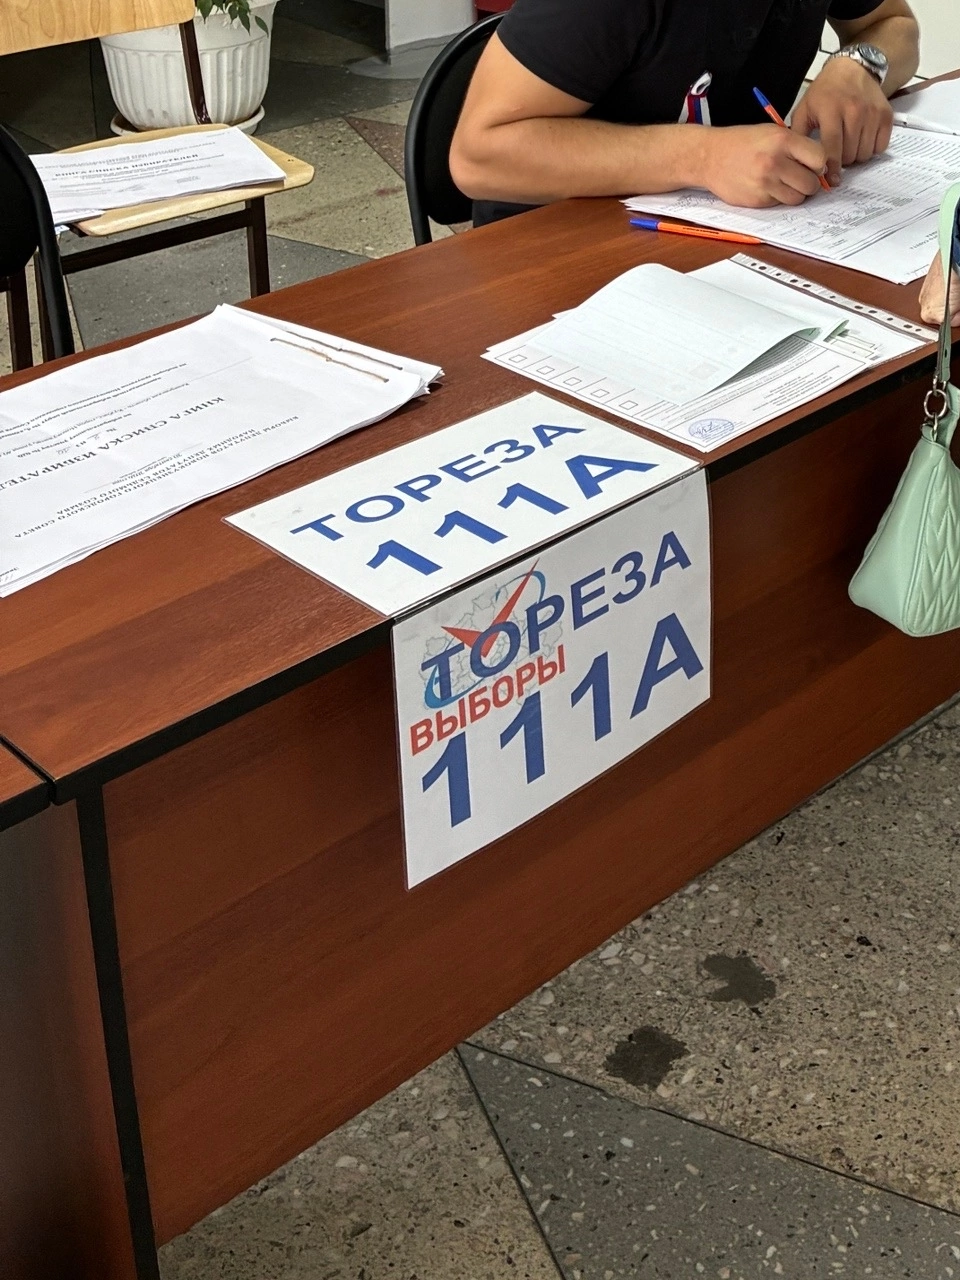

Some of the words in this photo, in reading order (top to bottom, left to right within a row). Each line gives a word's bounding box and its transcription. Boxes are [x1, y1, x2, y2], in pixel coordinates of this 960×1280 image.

[98, 420, 167, 450] СПИСКА
[169, 397, 224, 420] КНИГА
[290, 423, 586, 541] ТОРЕЗА
[366, 454, 660, 576] 111А
[420, 531, 692, 703] ТОРЕЗА
[410, 645, 566, 756] ВЫБОРЫ
[422, 613, 704, 828] 111А
